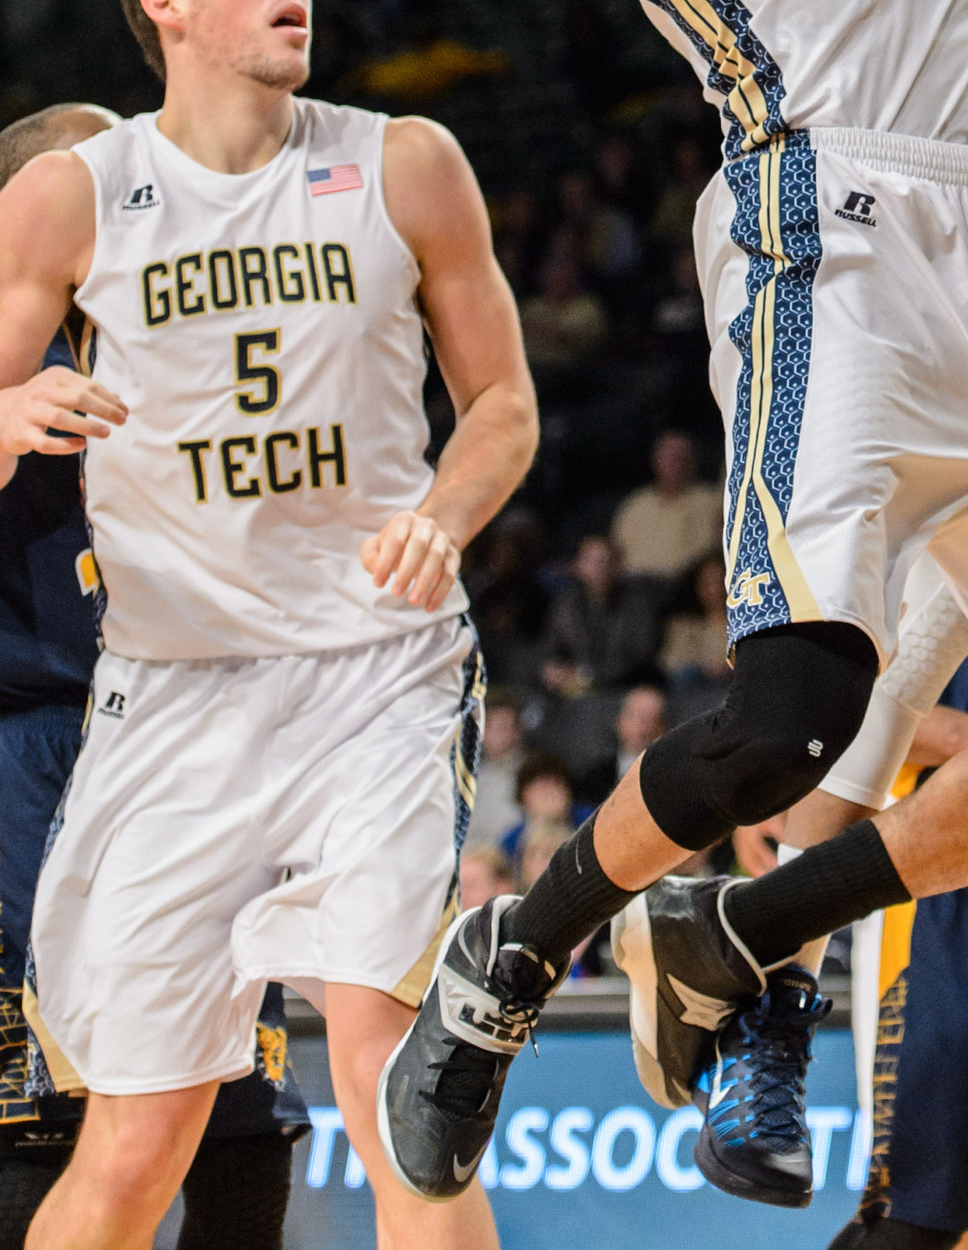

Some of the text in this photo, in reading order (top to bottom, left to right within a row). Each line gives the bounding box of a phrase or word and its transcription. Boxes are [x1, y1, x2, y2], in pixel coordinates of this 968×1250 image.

[834, 209, 878, 228] RUSSELL
[141, 241, 358, 329] GEORGIA
[233, 326, 282, 416] 5
[176, 423, 348, 504] TECH
